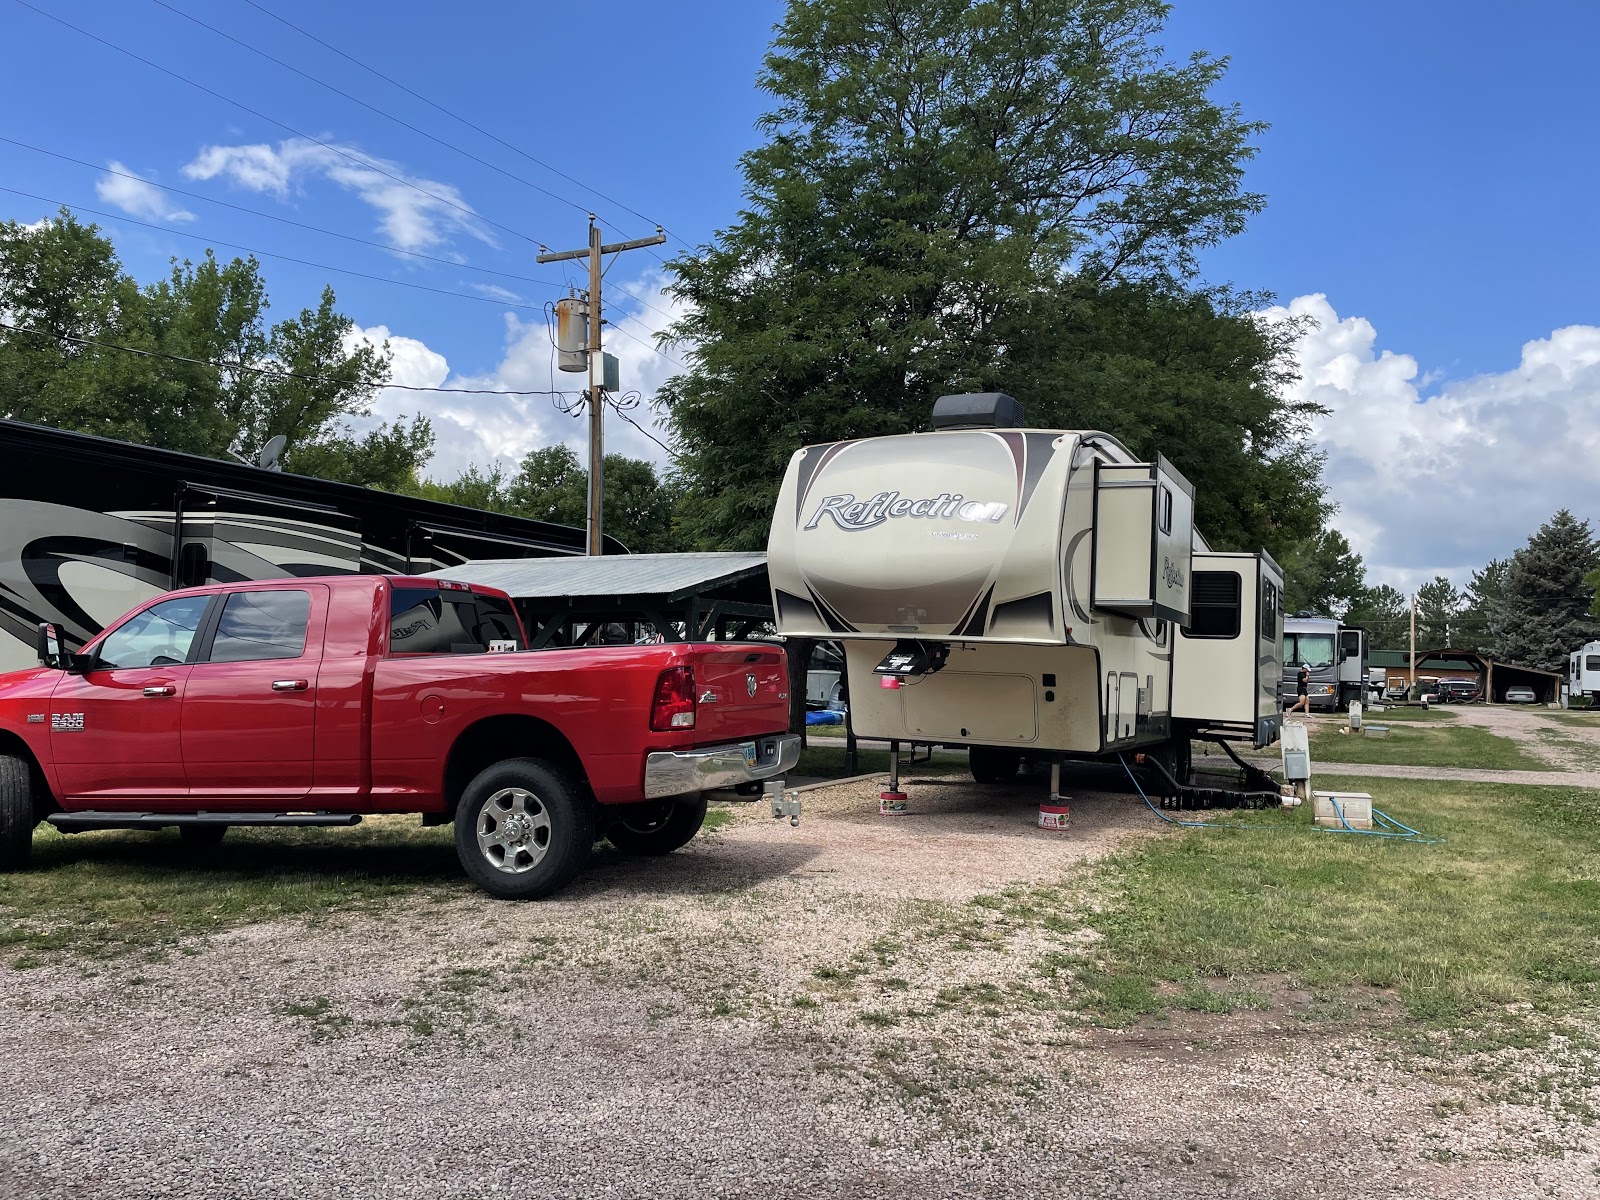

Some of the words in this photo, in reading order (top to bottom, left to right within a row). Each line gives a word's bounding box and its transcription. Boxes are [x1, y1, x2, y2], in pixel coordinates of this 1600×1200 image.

[803, 491, 1009, 532] Reflection
[51, 713, 85, 721] RAM
[51, 720, 85, 728] 2500
